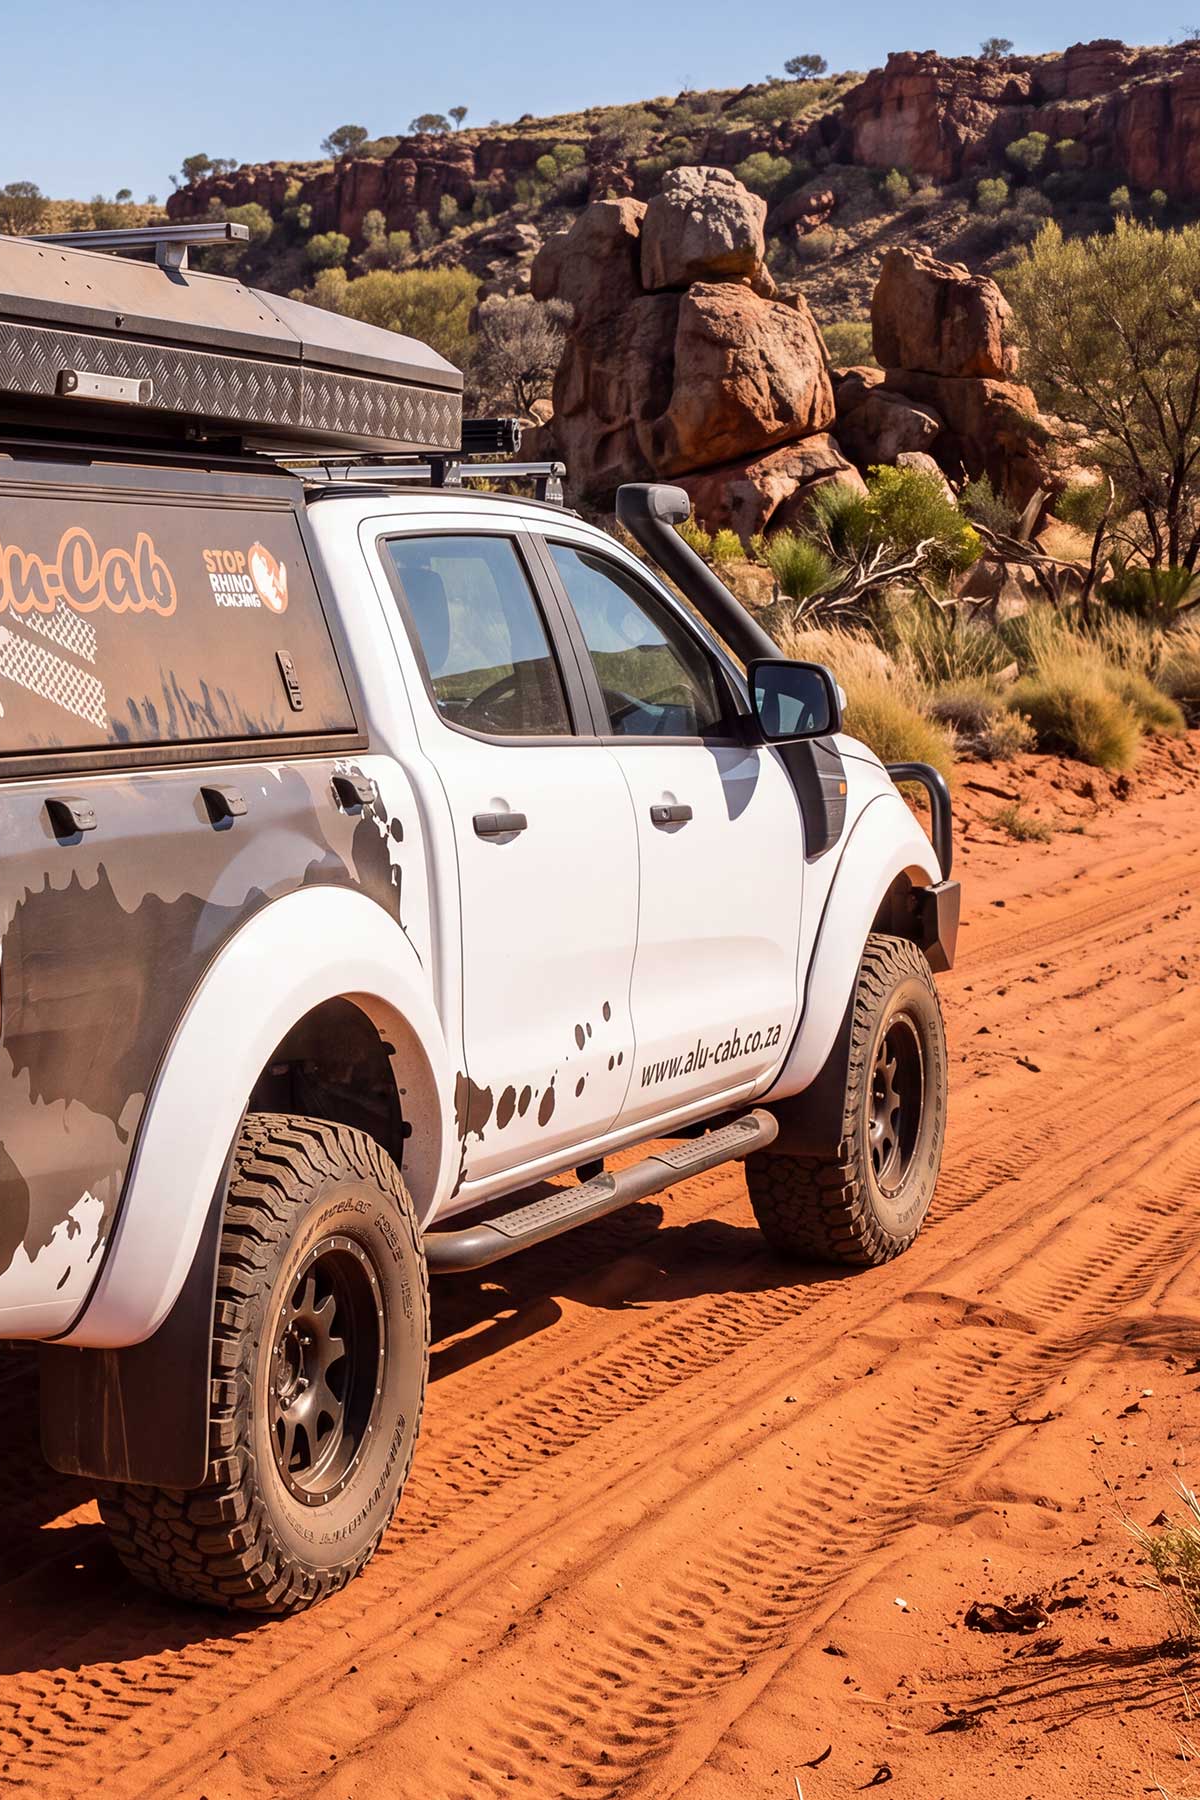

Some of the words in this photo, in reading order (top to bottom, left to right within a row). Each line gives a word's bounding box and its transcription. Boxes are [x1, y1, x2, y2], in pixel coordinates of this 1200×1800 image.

[202, 548, 246, 574] STOP
[208, 573, 254, 593] RHINO
[640, 1023, 782, 1089] www.alu-cab.co.za
